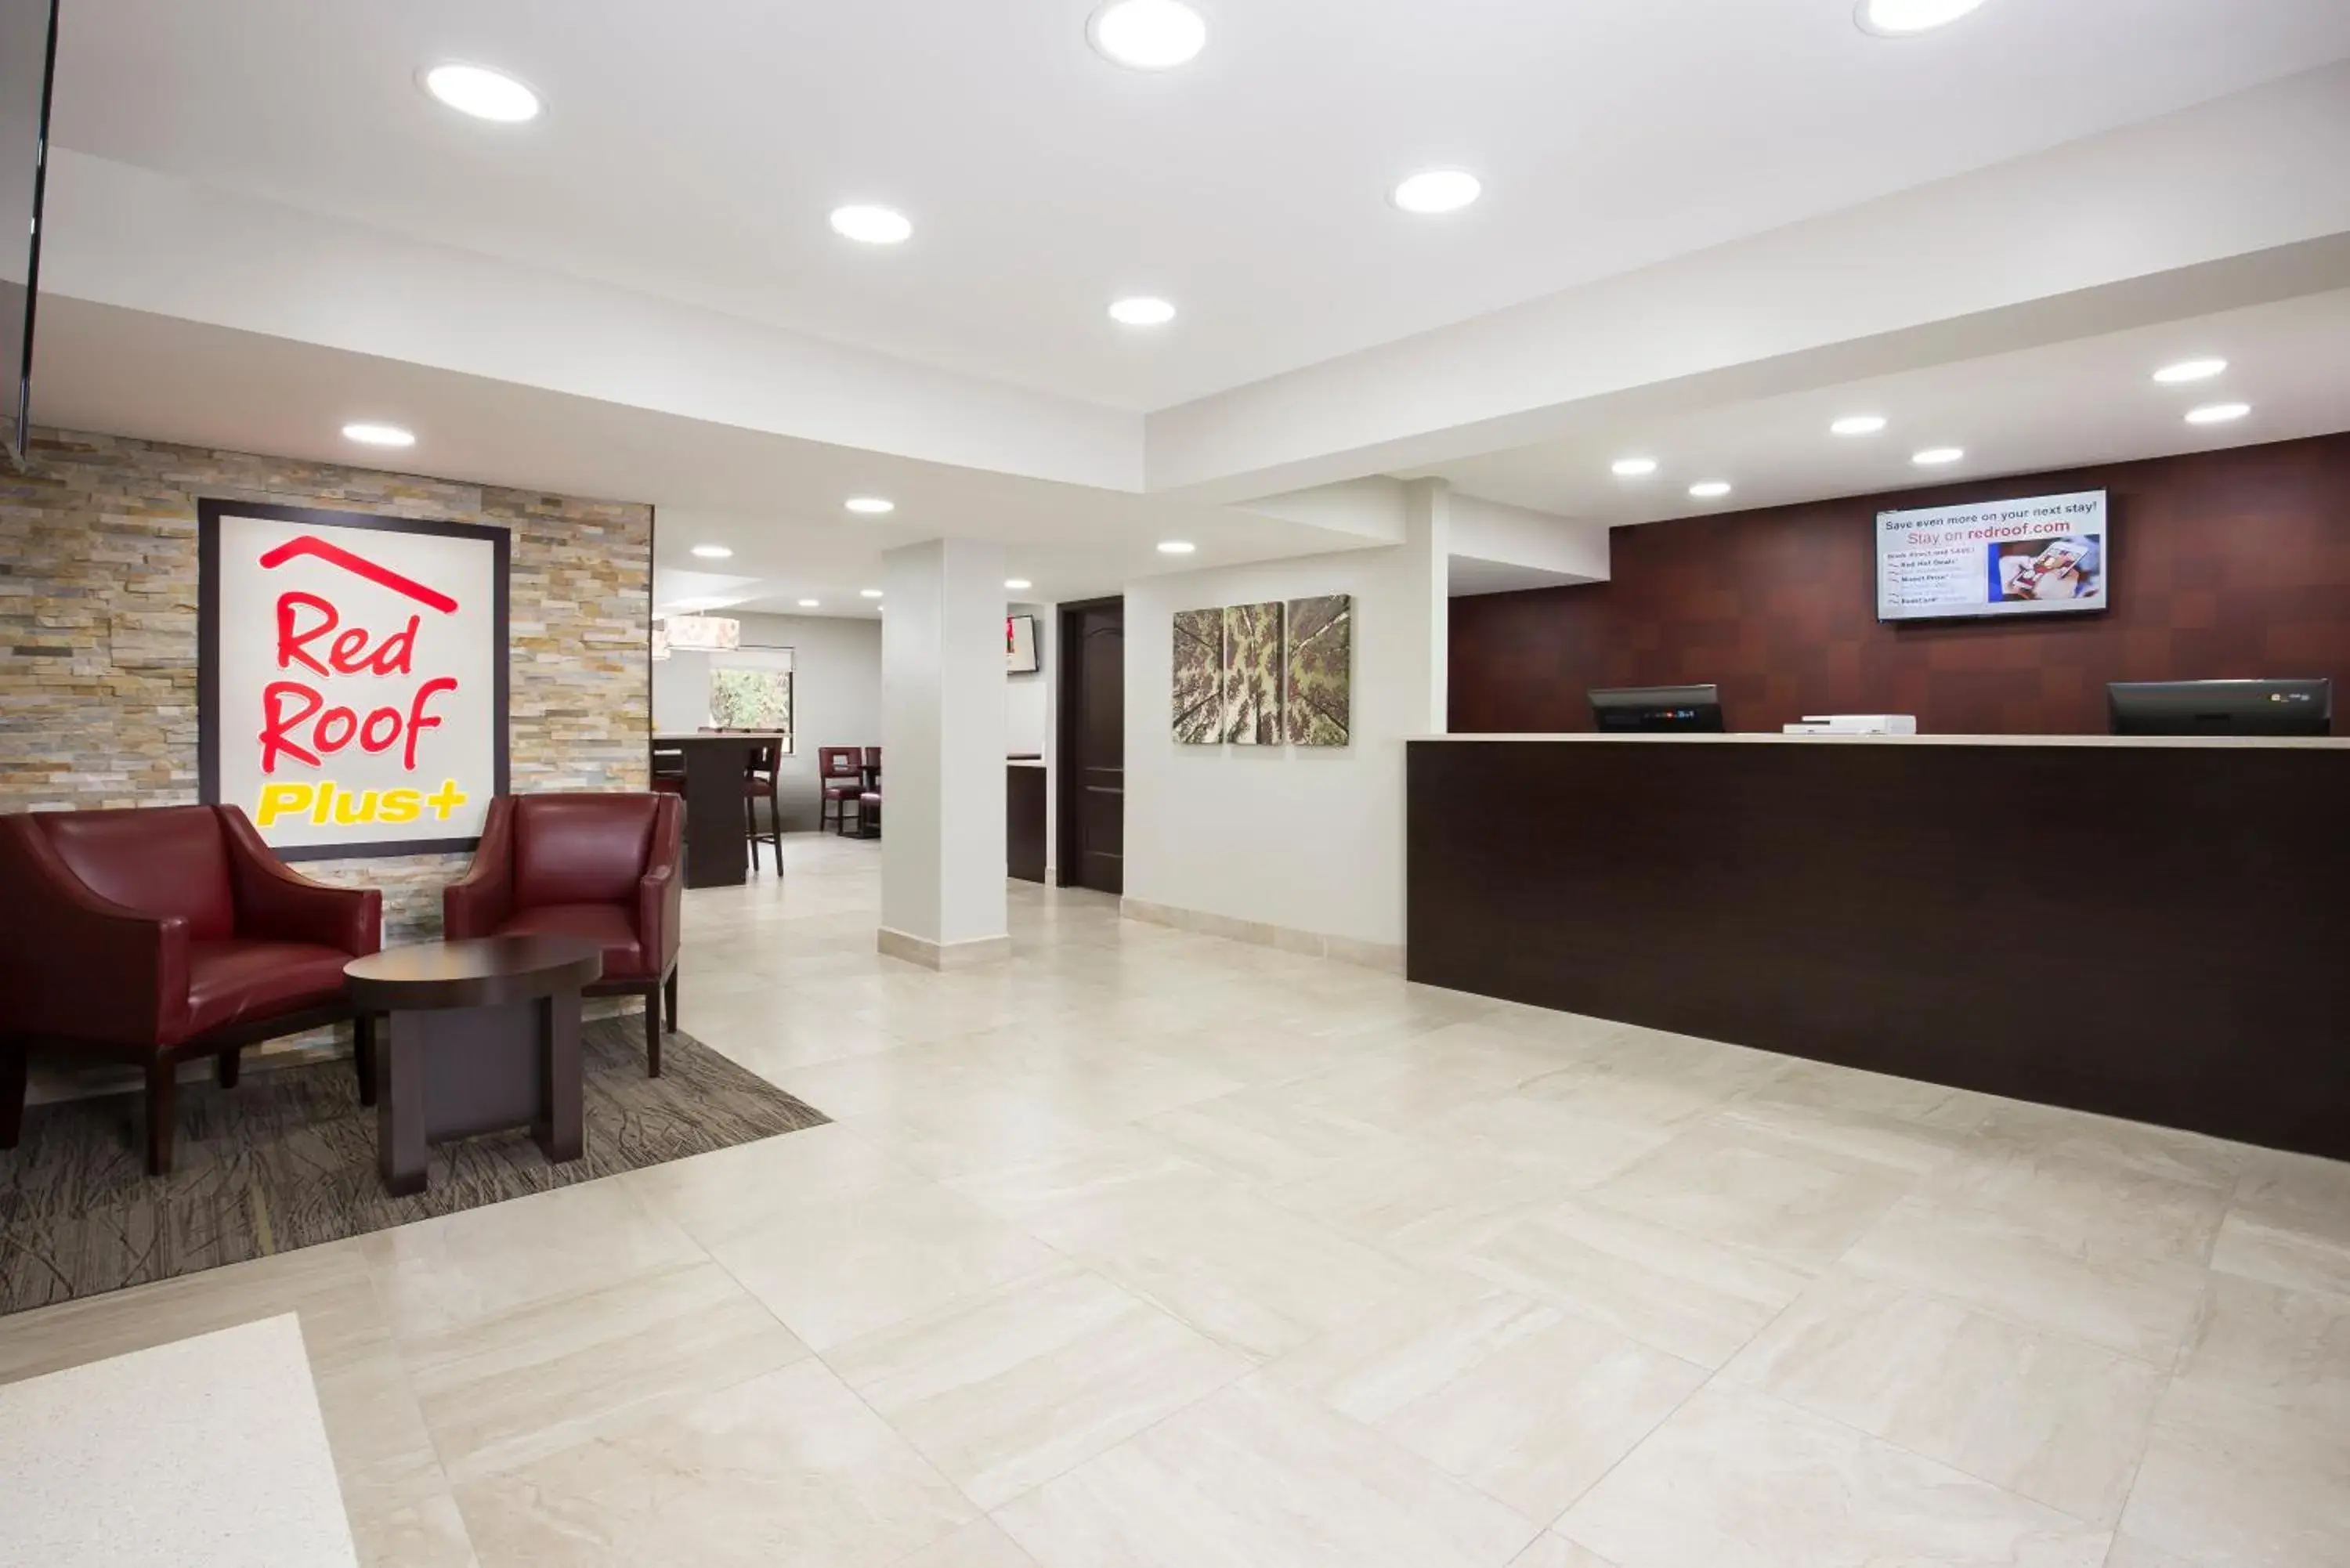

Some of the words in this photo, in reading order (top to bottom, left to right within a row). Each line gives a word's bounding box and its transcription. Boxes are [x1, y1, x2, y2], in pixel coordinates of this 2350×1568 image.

[1885, 521, 1913, 530] Save
[1916, 518, 1943, 527] even
[1947, 515, 1978, 524] more
[2001, 510, 2030, 522] your
[2033, 505, 2062, 516] next
[2065, 500, 2097, 513] stay!
[1907, 533, 1940, 546] Stay
[1945, 532, 1962, 541] on
[1968, 522, 2070, 539] redroof.com
[277, 591, 421, 677] Red
[258, 677, 458, 774] Roof
[255, 778, 468, 828] Plus+
